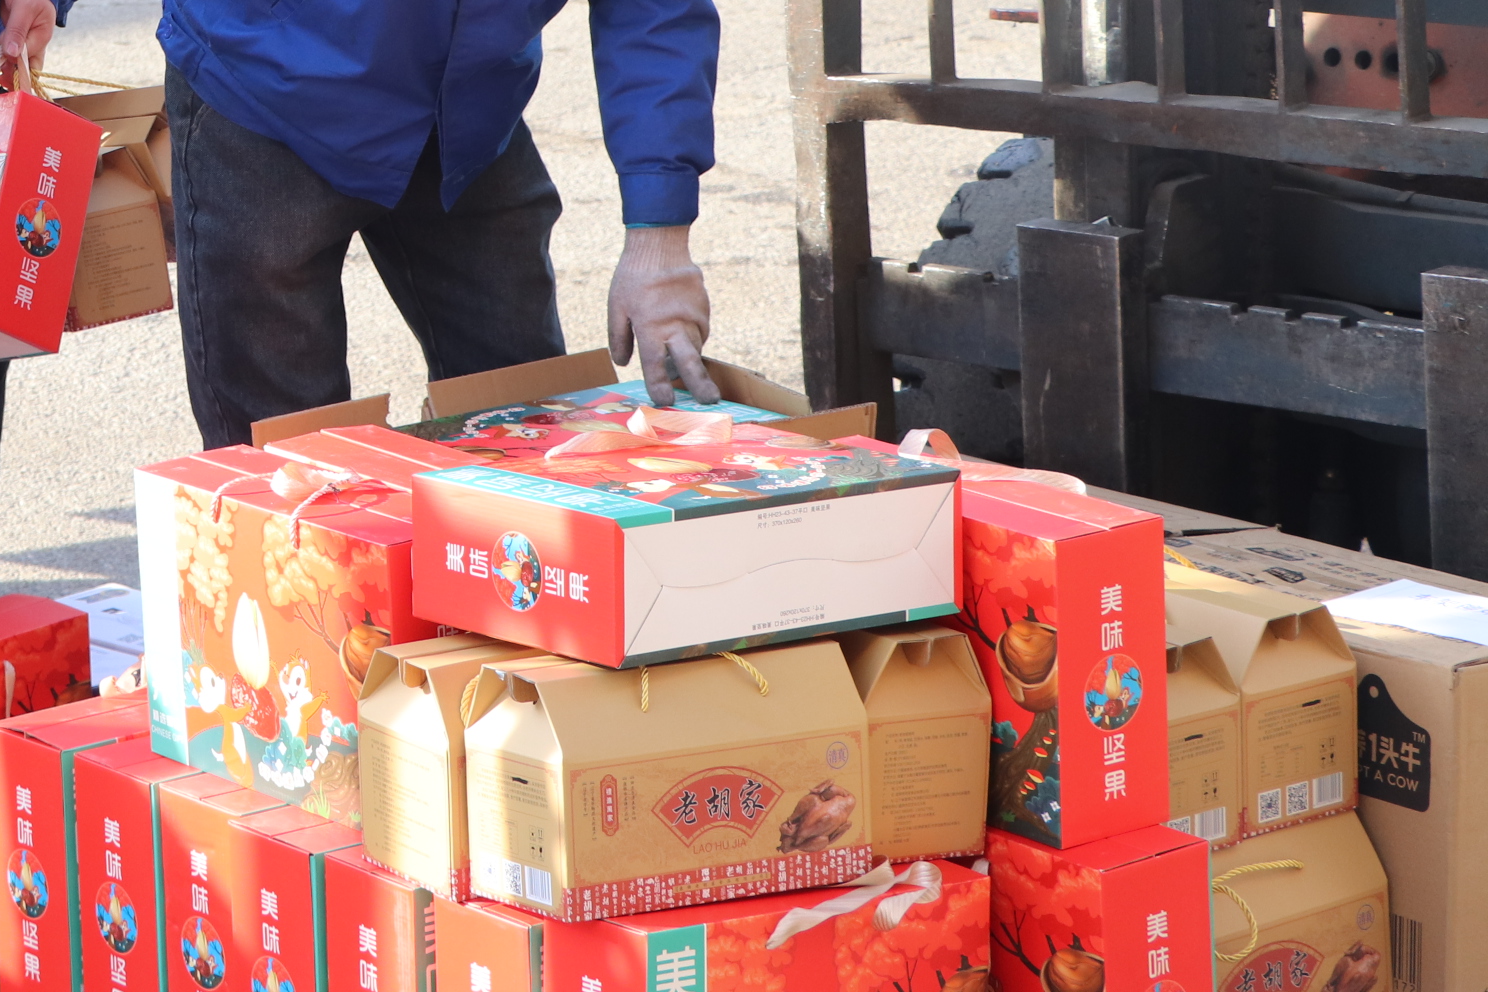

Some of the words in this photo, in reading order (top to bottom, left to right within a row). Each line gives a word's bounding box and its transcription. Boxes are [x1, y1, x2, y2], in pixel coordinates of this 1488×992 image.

[37, 146, 62, 199] 美味
[14, 256, 40, 310] 坚果
[445, 542, 489, 579] 美味
[545, 565, 589, 604] 坚果
[1100, 584, 1123, 651] 美味
[152, 724, 172, 739] CHINESE
[829, 748, 847, 764] 清真
[1412, 731, 1426, 744] TM
[1103, 733, 1126, 801] 坚果
[1374, 769, 1383, 783] A
[1387, 773, 1419, 792] COW
[16, 785, 33, 847] 美味
[672, 779, 767, 826] 老胡家
[104, 817, 123, 881] 美味
[692, 841, 714, 855] LAO
[715, 840, 730, 851] HU
[733, 838, 748, 850] JIA
[190, 849, 209, 915] 美味
[22, 919, 40, 982] 坚果
[260, 888, 281, 955] 美味
[1146, 910, 1170, 979] 美味
[110, 954, 127, 992] 坚
[359, 924, 378, 992] 美味
[1235, 950, 1311, 992] 老胡家
